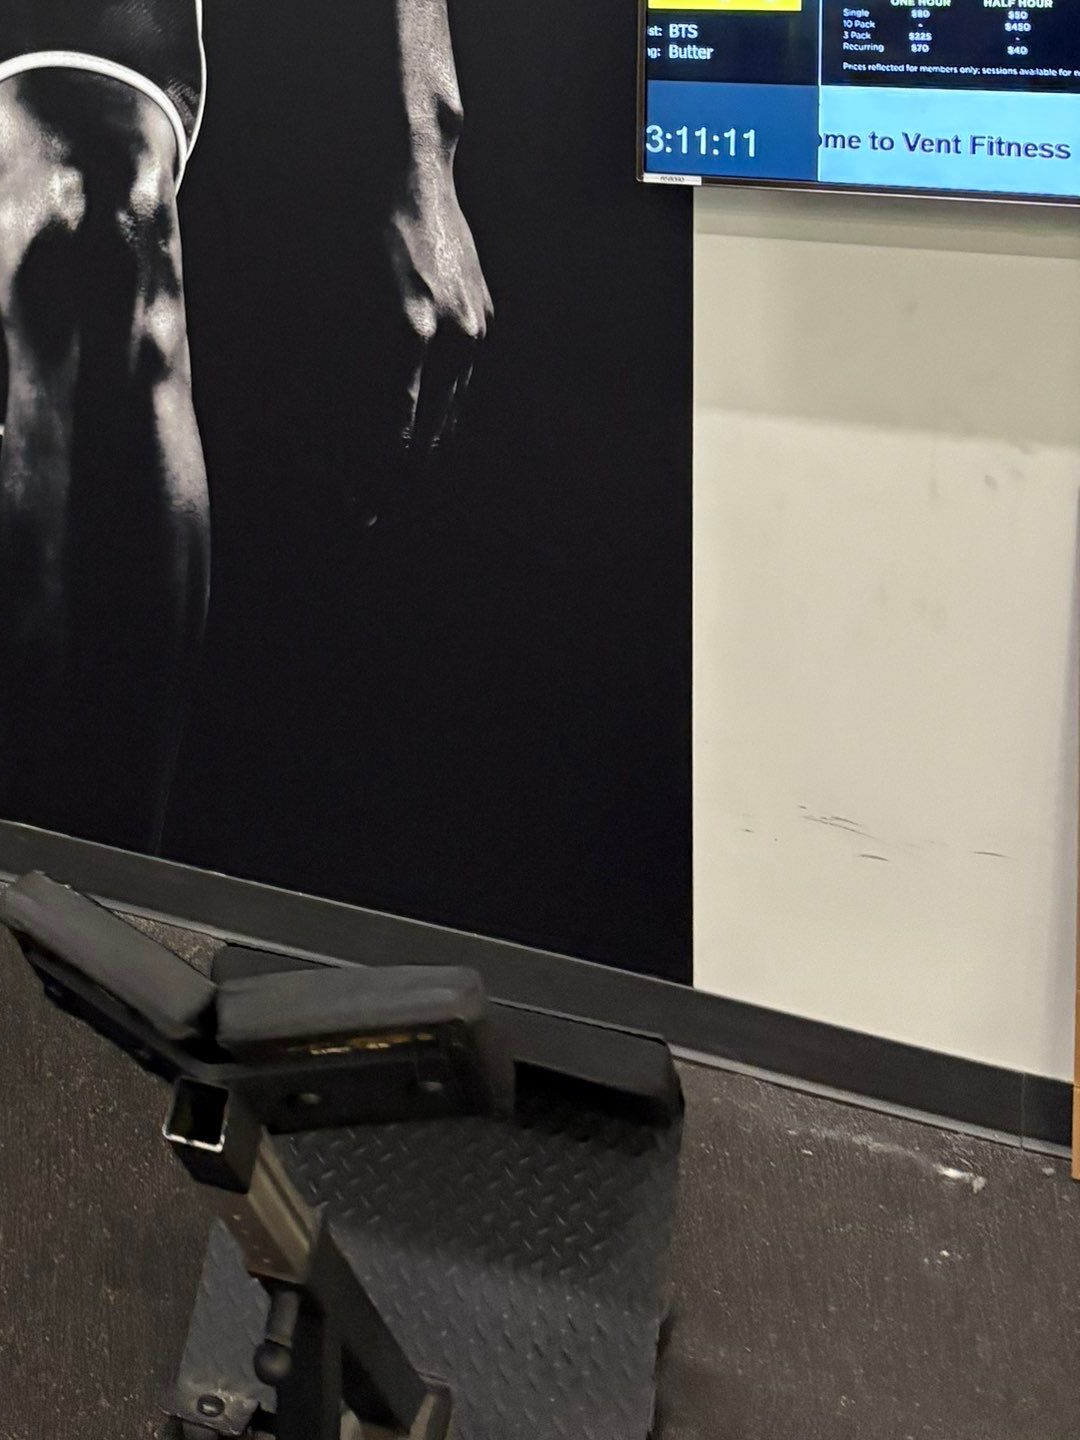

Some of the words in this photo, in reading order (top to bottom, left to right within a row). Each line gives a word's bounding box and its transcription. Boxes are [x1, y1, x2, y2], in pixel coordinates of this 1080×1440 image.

[843, 8, 870, 17] Single
[1008, 10, 1029, 20] $50
[843, 20, 853, 28] 10
[854, 20, 876, 28] Pack
[1004, 22, 1032, 32] $450
[647, 25, 663, 36] st:
[669, 24, 698, 38] BTS
[851, 31, 872, 39] Pack
[909, 32, 932, 41] $225
[669, 44, 714, 59] Butter
[843, 42, 885, 52] Recurring
[911, 44, 930, 53] $70
[1007, 46, 1028, 55] $40
[843, 62, 866, 70] Prices
[868, 63, 904, 72] reflected
[906, 64, 918, 72] for
[920, 65, 958, 73] members
[982, 67, 1018, 75] sessions
[1019, 68, 1057, 76] available
[1059, 68, 1072, 76] for
[646, 125, 756, 157] 3:11:11
[870, 132, 894, 150] to
[902, 133, 961, 154] Vent
[970, 135, 1071, 160] Fitness
